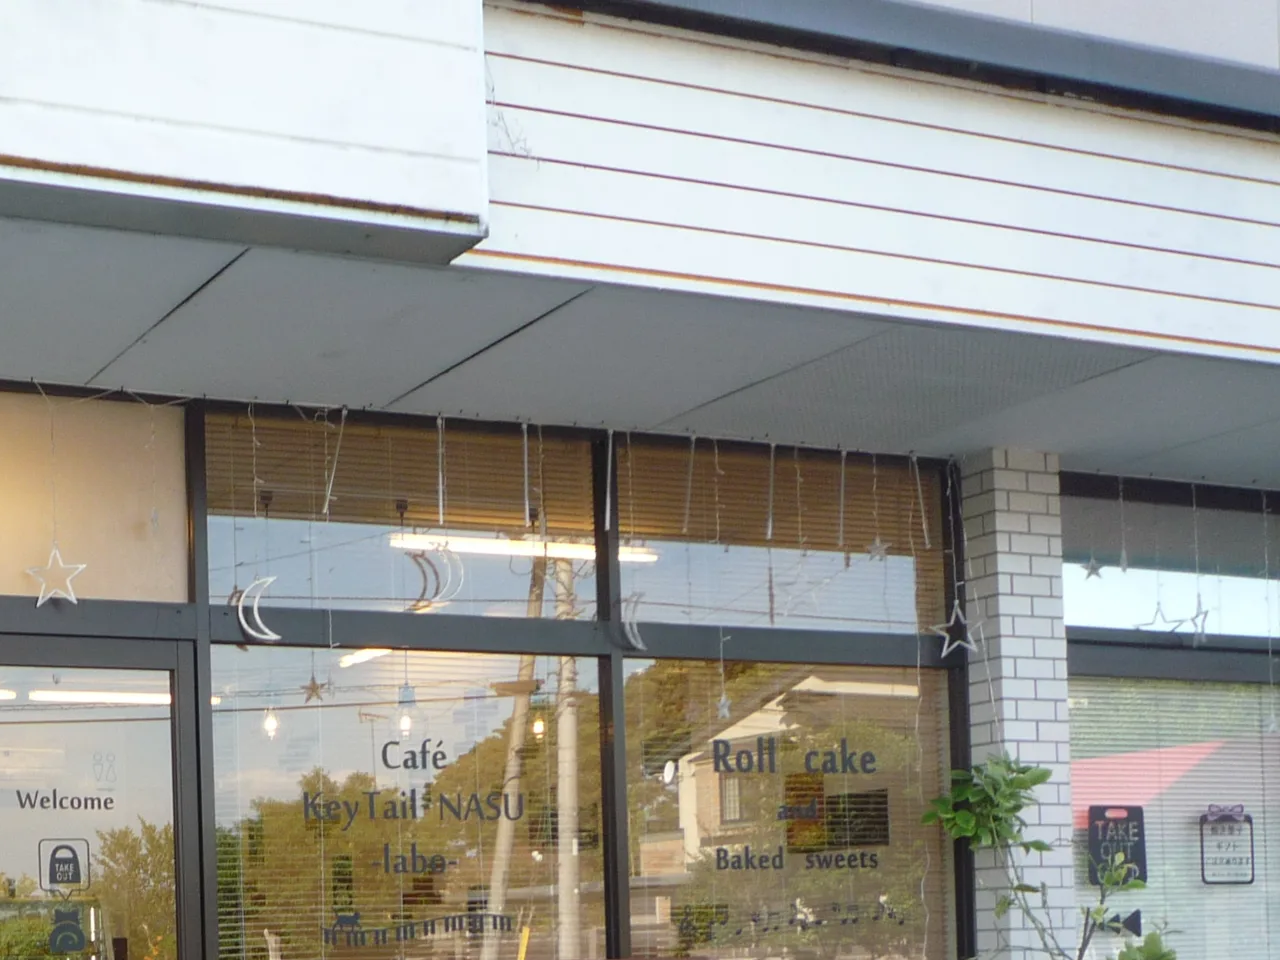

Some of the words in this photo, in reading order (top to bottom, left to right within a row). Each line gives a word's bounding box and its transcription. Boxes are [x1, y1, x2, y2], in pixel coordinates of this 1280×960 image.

[381, 739, 448, 770] Café
[712, 737, 777, 775] Roll
[804, 738, 878, 775] cake
[15, 787, 116, 812] Welcome
[302, 790, 418, 832] KeyTail
[439, 791, 525, 822] NASU
[776, 798, 818, 821] and
[1095, 821, 1140, 841] TAKE
[715, 846, 785, 871] Baked
[804, 848, 879, 871] sweets
[1100, 842, 1135, 860] OUT
[54, 862, 75, 873] TAKE
[56, 872, 74, 882] OUT
